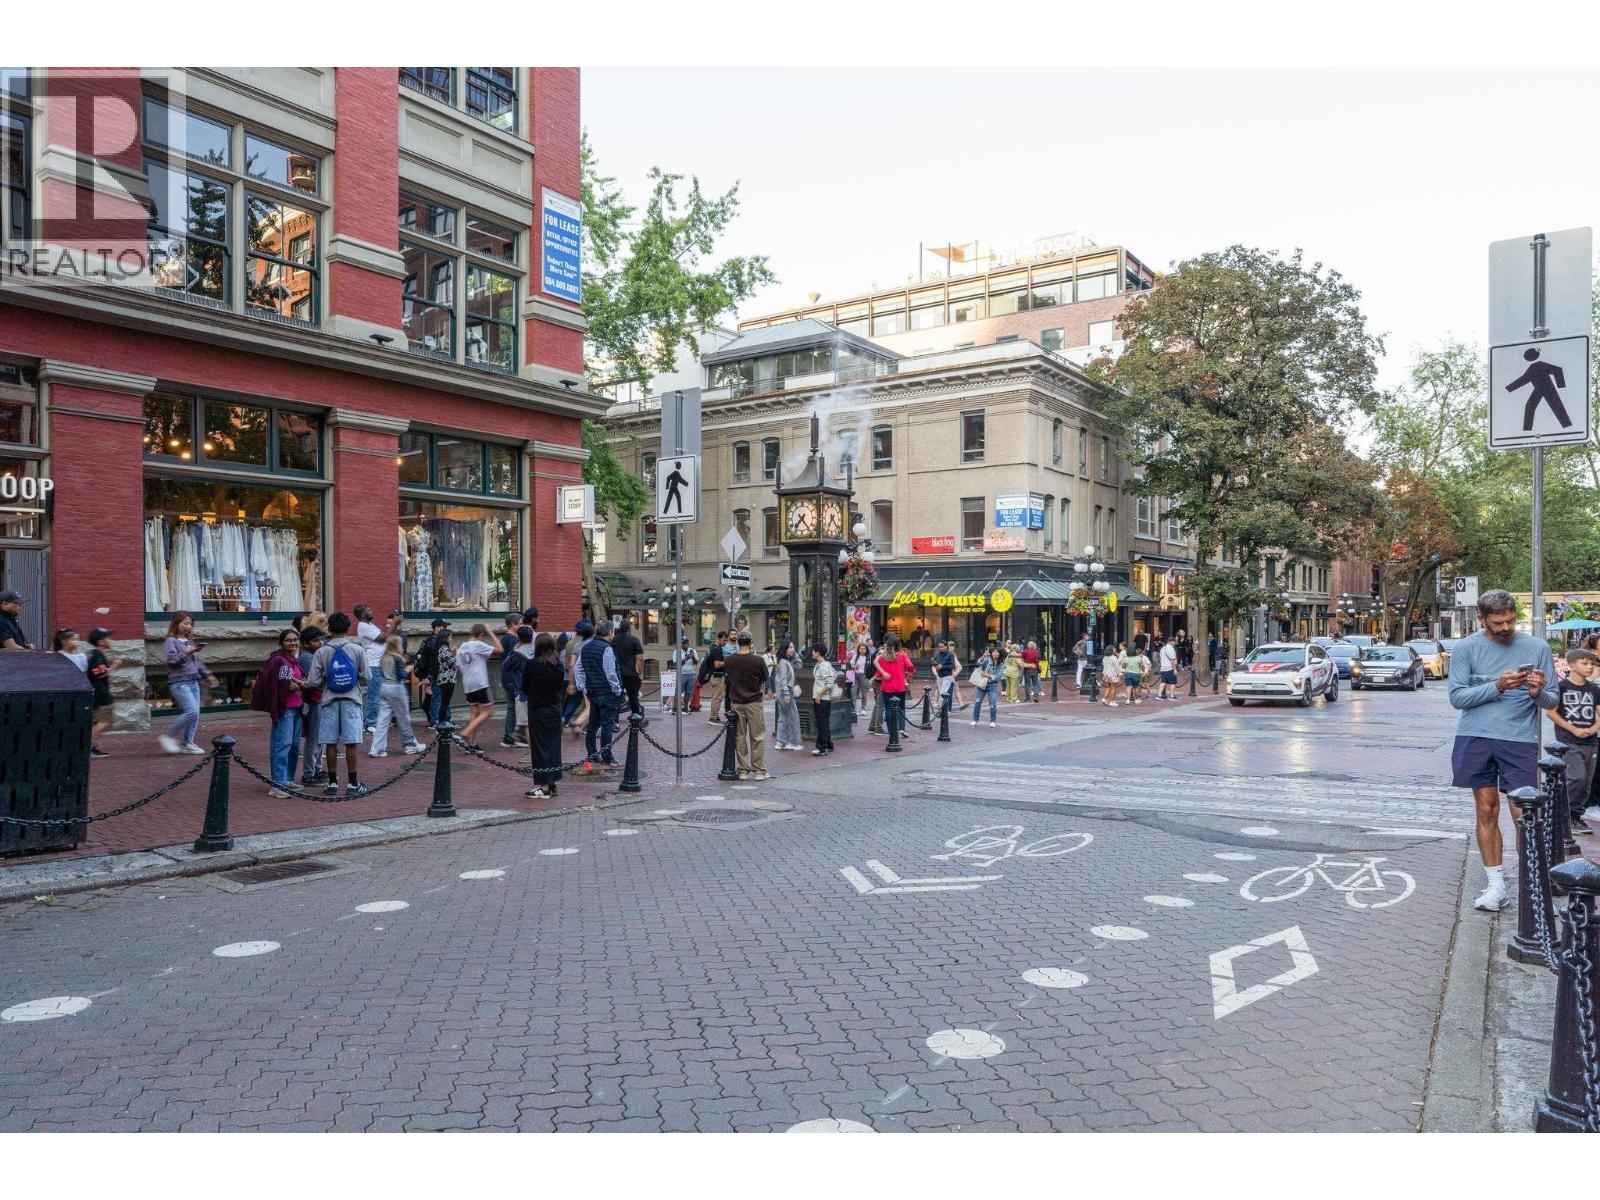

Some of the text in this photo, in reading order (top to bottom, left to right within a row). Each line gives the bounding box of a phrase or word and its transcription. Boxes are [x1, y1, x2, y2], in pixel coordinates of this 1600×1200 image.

[545, 213, 579, 236] FOR LEASE
[215, 585, 249, 596] LATEST
[889, 591, 985, 608] Lee's Donuts
